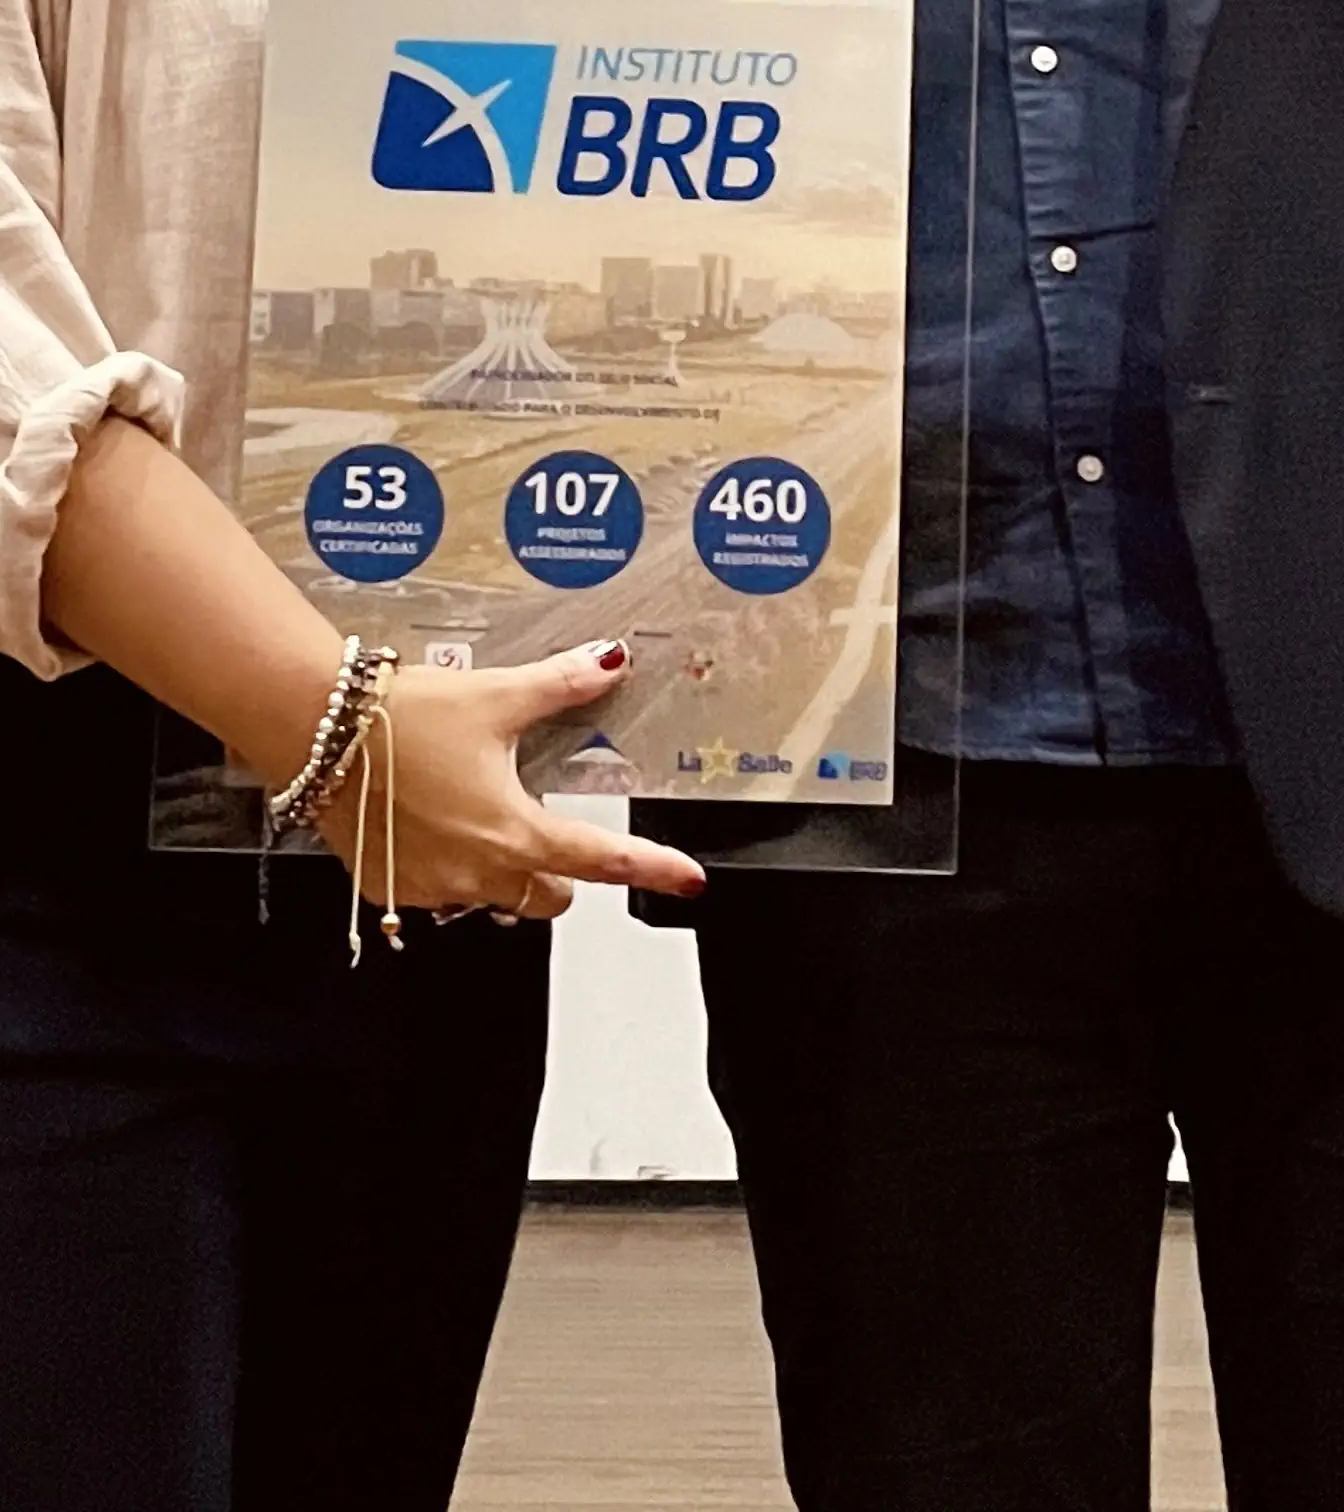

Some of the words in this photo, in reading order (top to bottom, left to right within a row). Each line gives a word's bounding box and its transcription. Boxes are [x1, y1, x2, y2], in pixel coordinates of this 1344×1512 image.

[576, 45, 798, 87] INSTITUTO
[556, 95, 781, 201] BRB
[343, 466, 406, 509] 53
[524, 472, 619, 516] 107
[709, 478, 806, 522] 460
